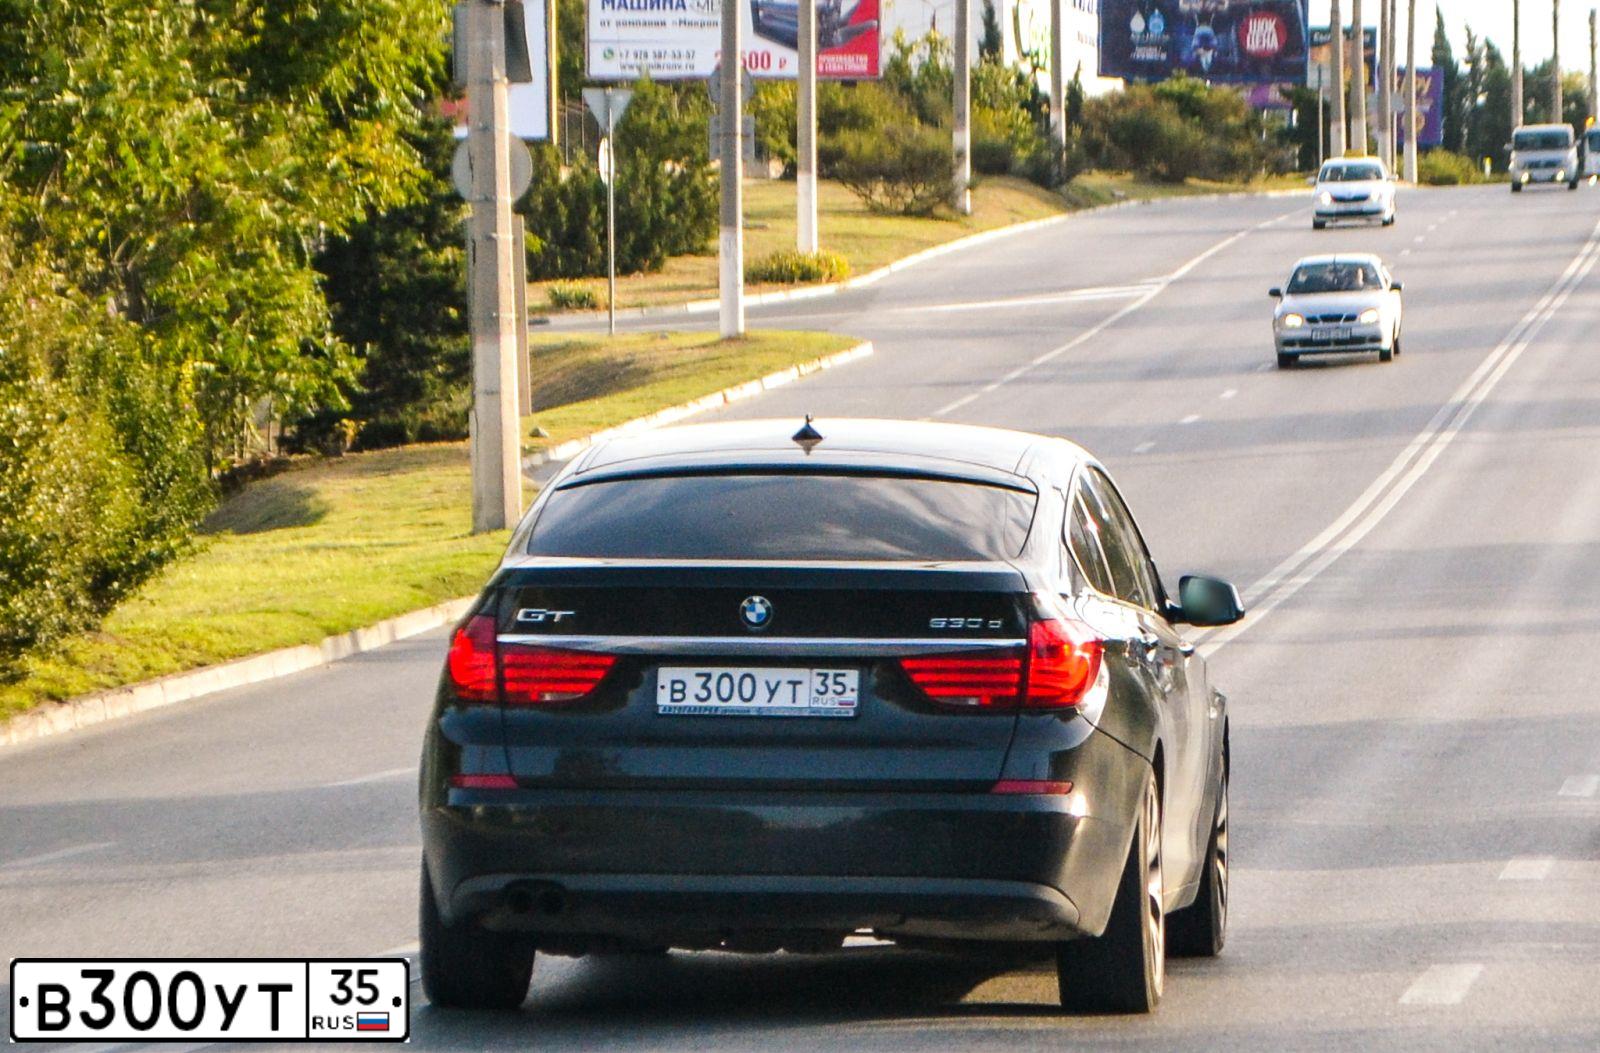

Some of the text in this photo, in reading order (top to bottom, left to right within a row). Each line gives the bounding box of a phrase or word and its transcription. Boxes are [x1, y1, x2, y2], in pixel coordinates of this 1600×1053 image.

[601, 0, 687, 10] МАШИНА
[1249, 17, 1277, 33] ШОК
[1246, 32, 1279, 51] ЦЕНА
[517, 608, 575, 622] GT
[815, 672, 847, 696] 35
[812, 697, 836, 706] RUS
